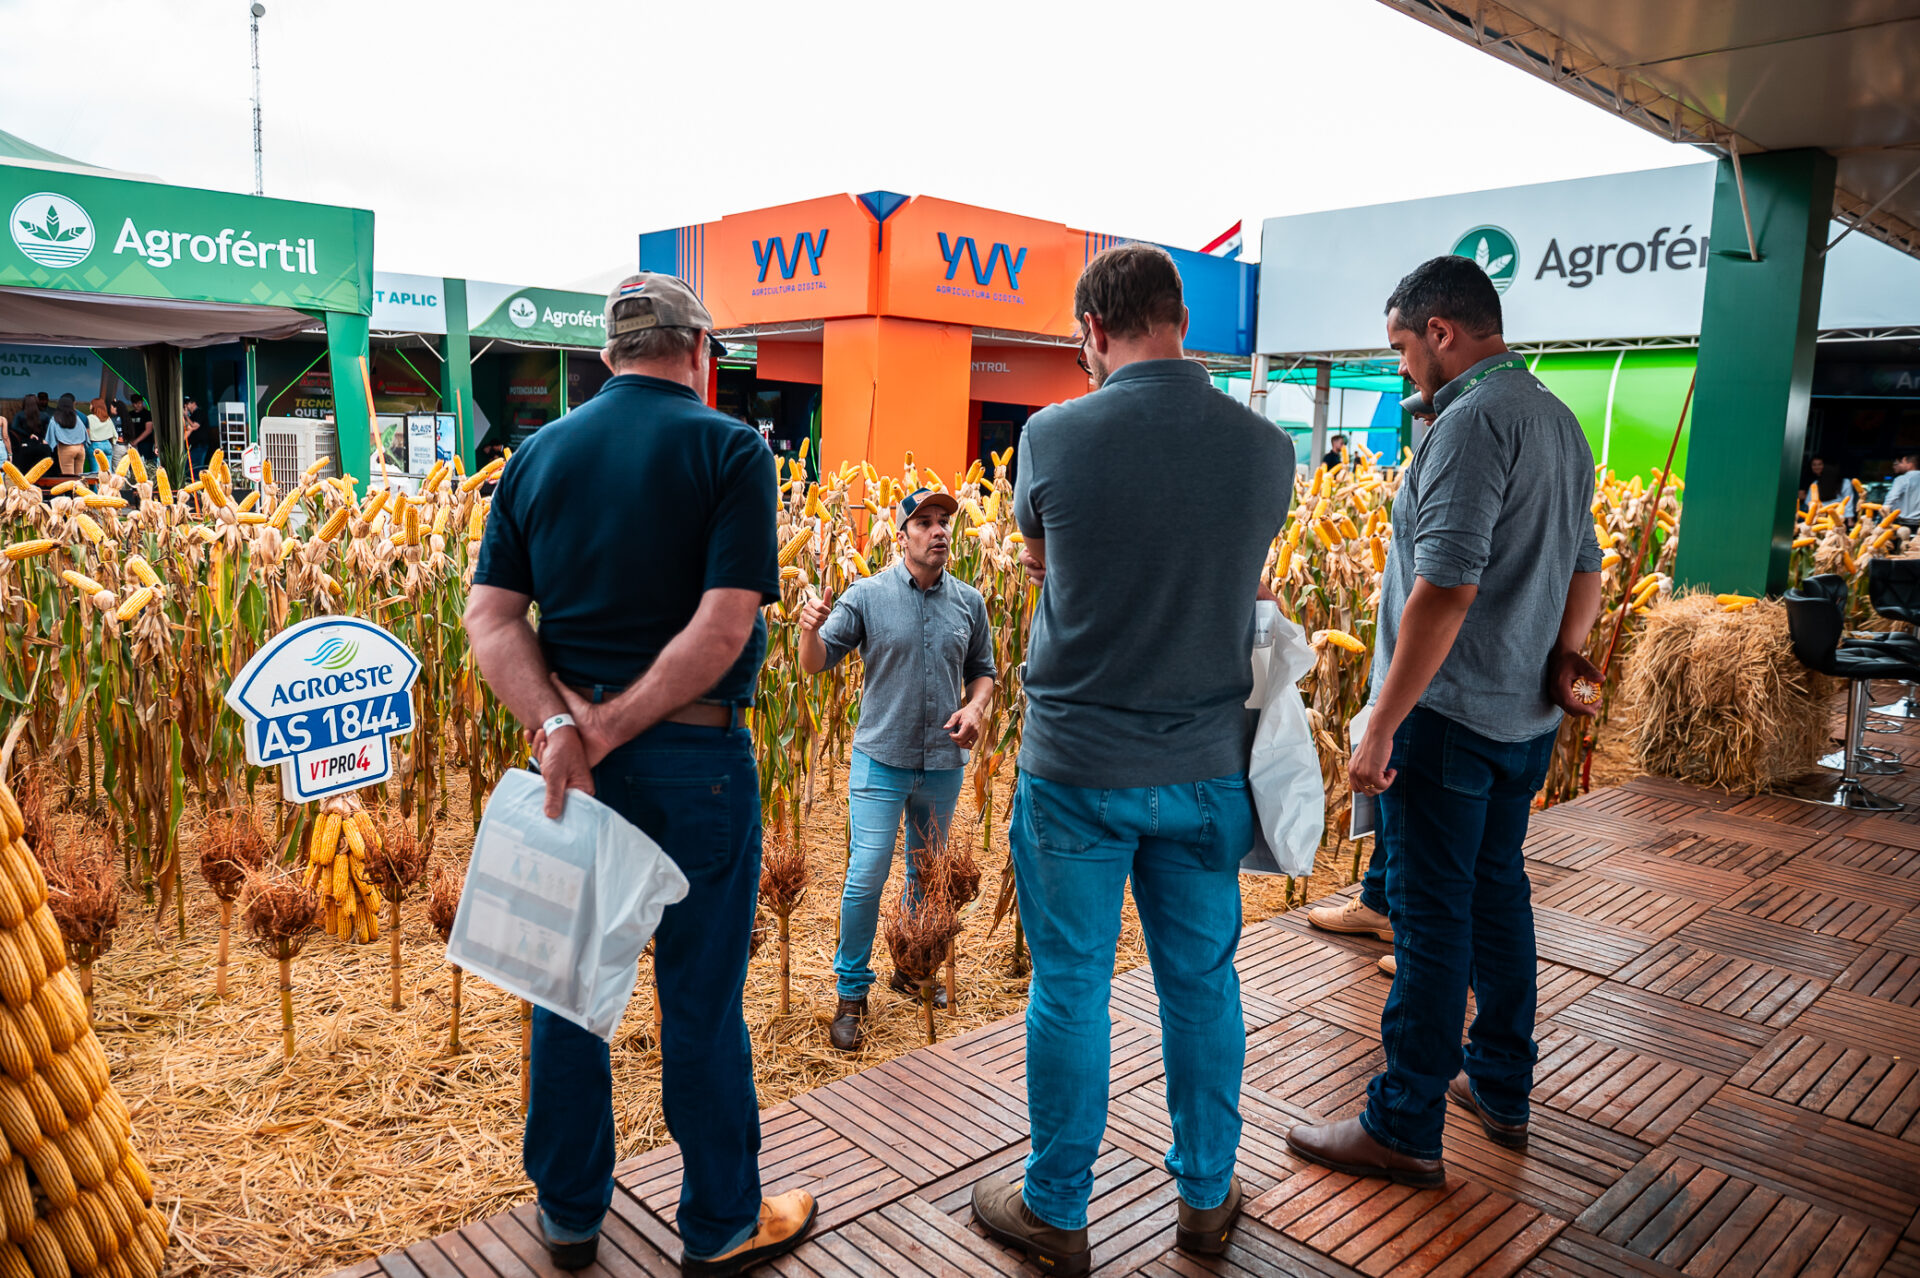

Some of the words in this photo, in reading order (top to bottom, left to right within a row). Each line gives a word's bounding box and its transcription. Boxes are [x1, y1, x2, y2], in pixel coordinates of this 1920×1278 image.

[112, 217, 319, 275] Agrofértil
[752, 228, 829, 283] YVY
[936, 231, 1028, 290] YVY
[751, 284, 796, 296] AGRICULTURA
[797, 281, 827, 292] DIGITAL
[936, 285, 991, 299] AGRICULTURA
[992, 292, 1025, 305] DIGITAL
[388, 291, 438, 308] APLIC
[1, 366, 31, 377] OLA
[971, 361, 1011, 373] NTROL
[295, 398, 334, 408] TECNO
[295, 408, 319, 418] QUE
[270, 664, 393, 707] AGROESTE
[261, 714, 312, 760] AS
[322, 696, 399, 744] 1844
